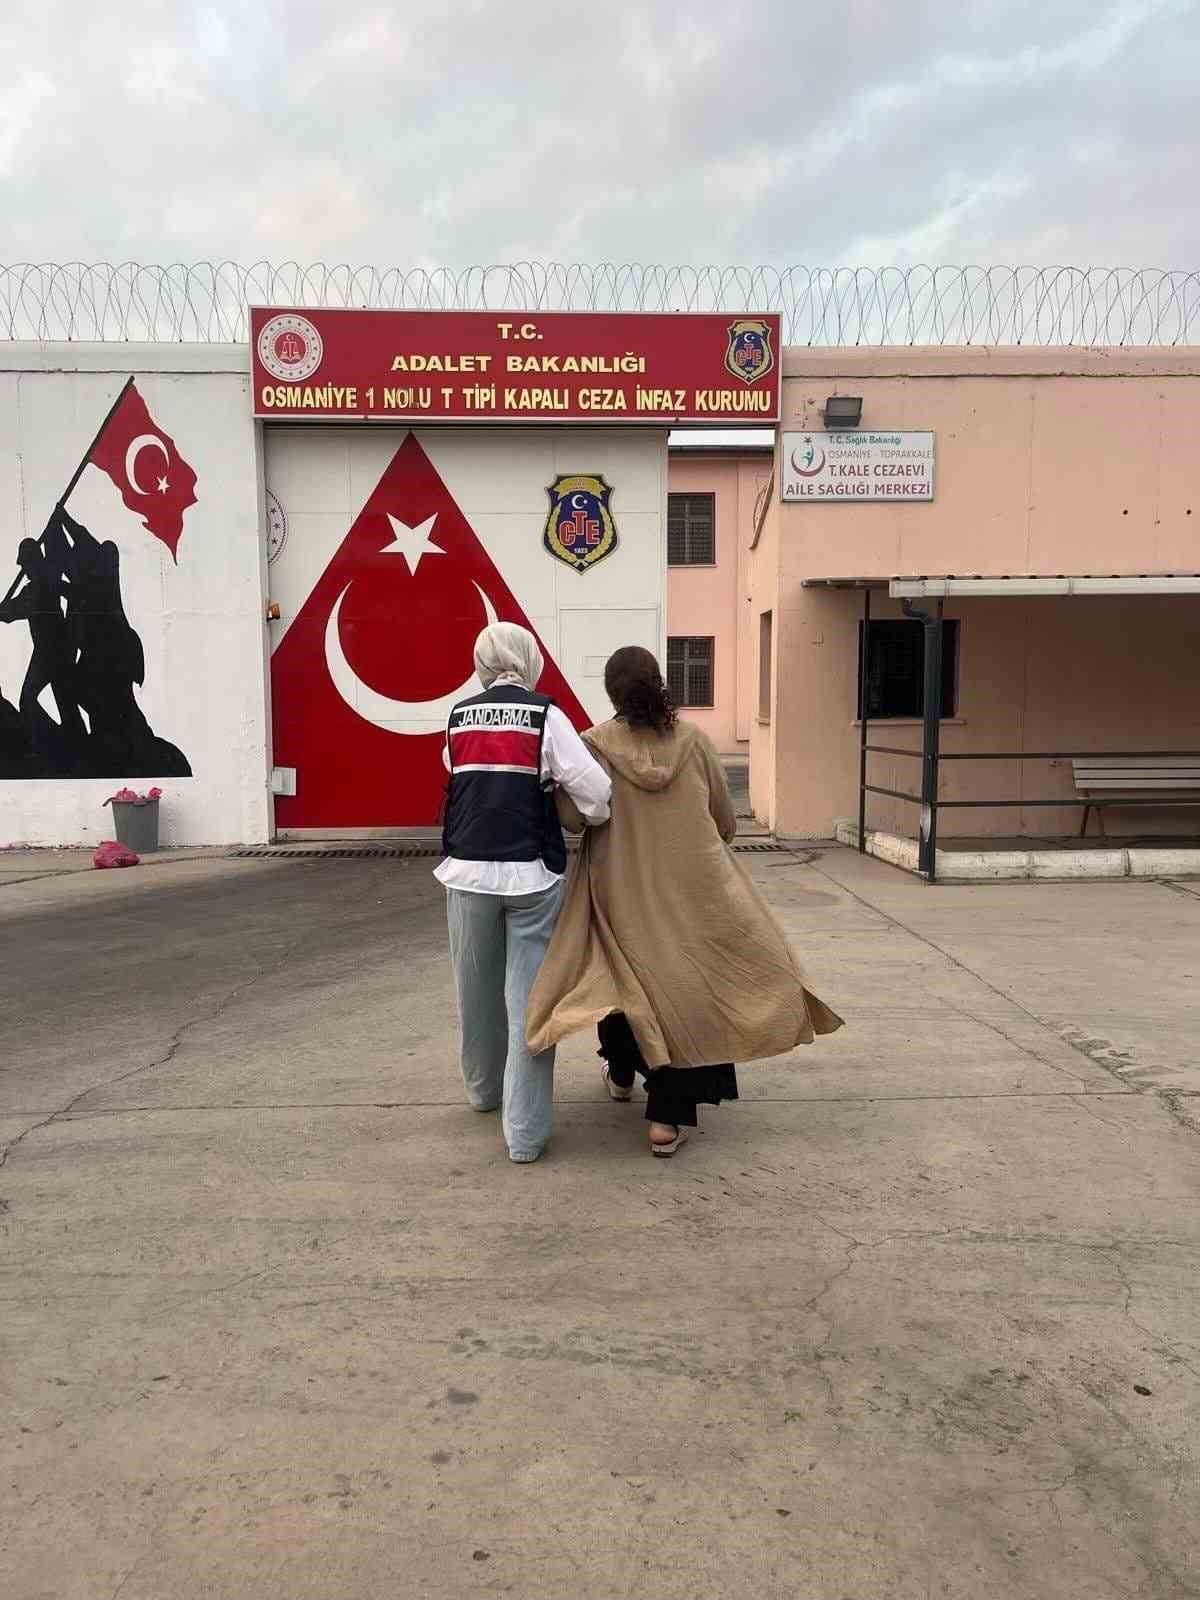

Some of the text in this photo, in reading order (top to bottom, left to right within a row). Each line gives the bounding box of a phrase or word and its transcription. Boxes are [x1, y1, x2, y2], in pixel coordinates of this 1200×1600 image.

[497, 323, 544, 340] T.C.
[391, 352, 646, 373] ADALET BAKANLIĞI
[262, 383, 357, 408] OSMANİYE
[365, 387, 374, 409] 1
[441, 387, 453, 409] T
[462, 384, 496, 409] TİPİ
[504, 387, 569, 410] KAPALI
[578, 388, 627, 410] CEZA
[636, 384, 686, 411] İNFAZ
[695, 390, 771, 412] KURUMU
[873, 463, 925, 477] CEZAEVİ
[786, 481, 930, 496] AİLE SAĞLIĞI MERKEZİ
[458, 708, 532, 727] JANDARMA
